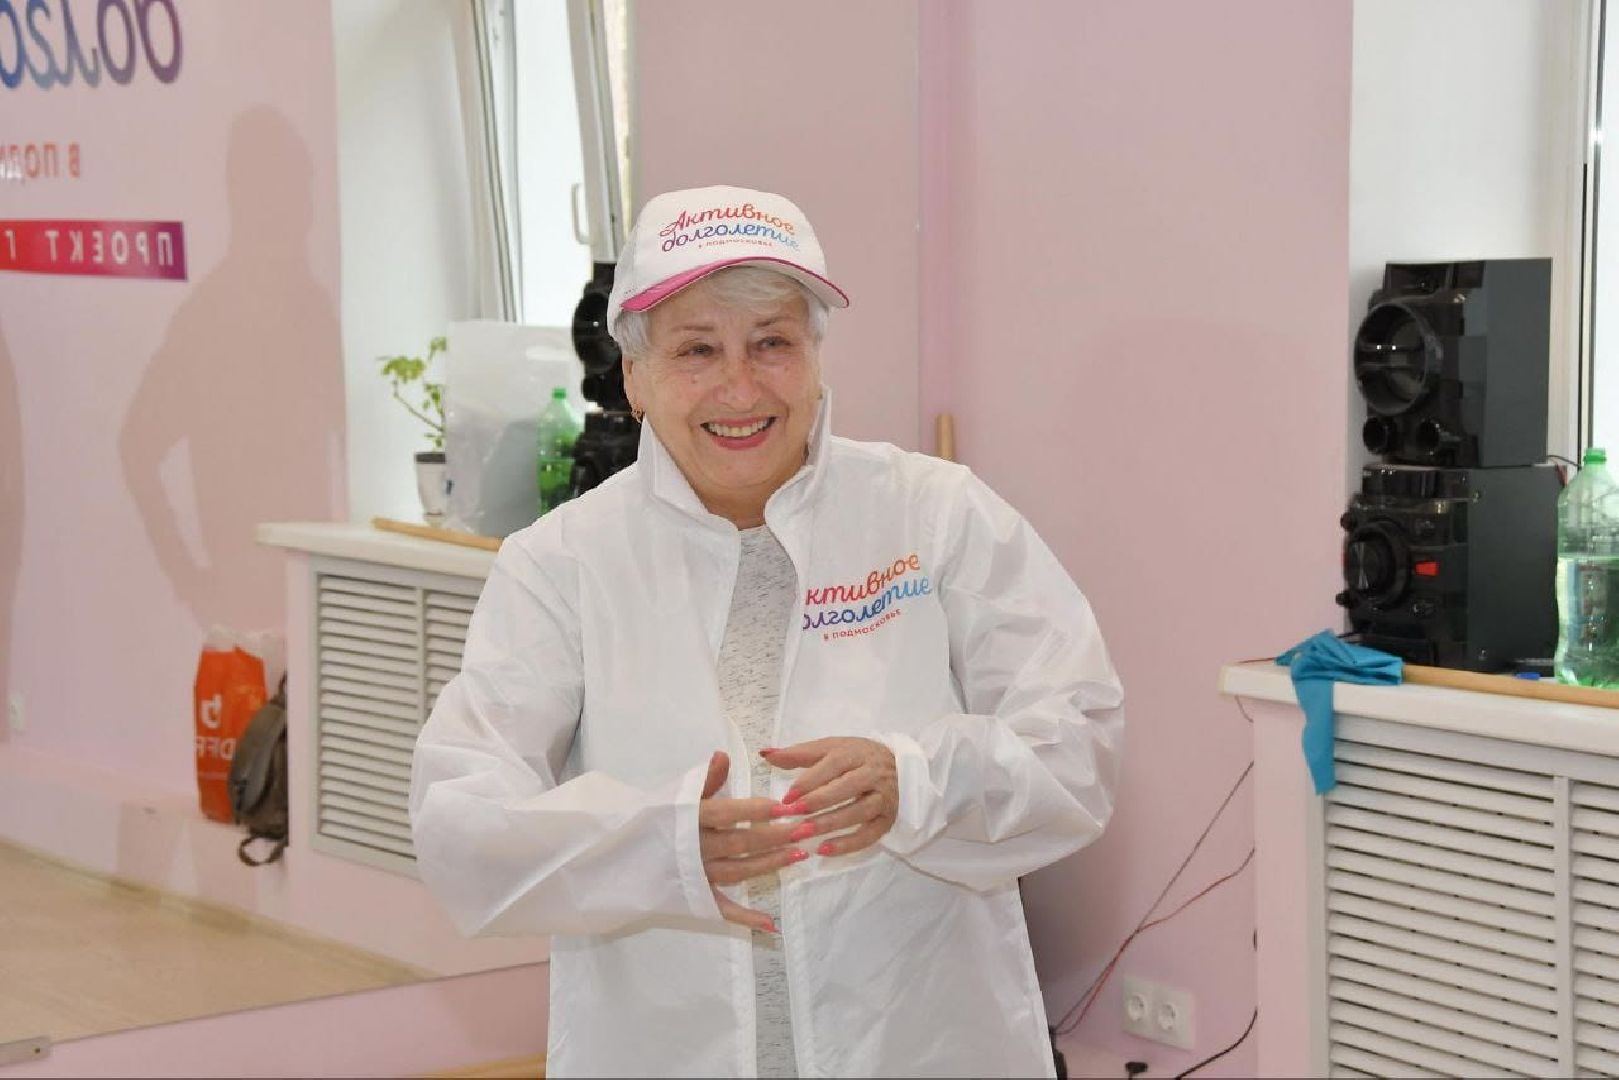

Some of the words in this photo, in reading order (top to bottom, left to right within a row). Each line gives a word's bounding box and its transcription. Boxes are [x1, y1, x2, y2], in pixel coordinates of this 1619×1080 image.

[660, 203, 796, 237] Активное
[662, 223, 800, 252] долголетие
[805, 554, 921, 606] ктивное
[802, 576, 932, 631] олголетие
